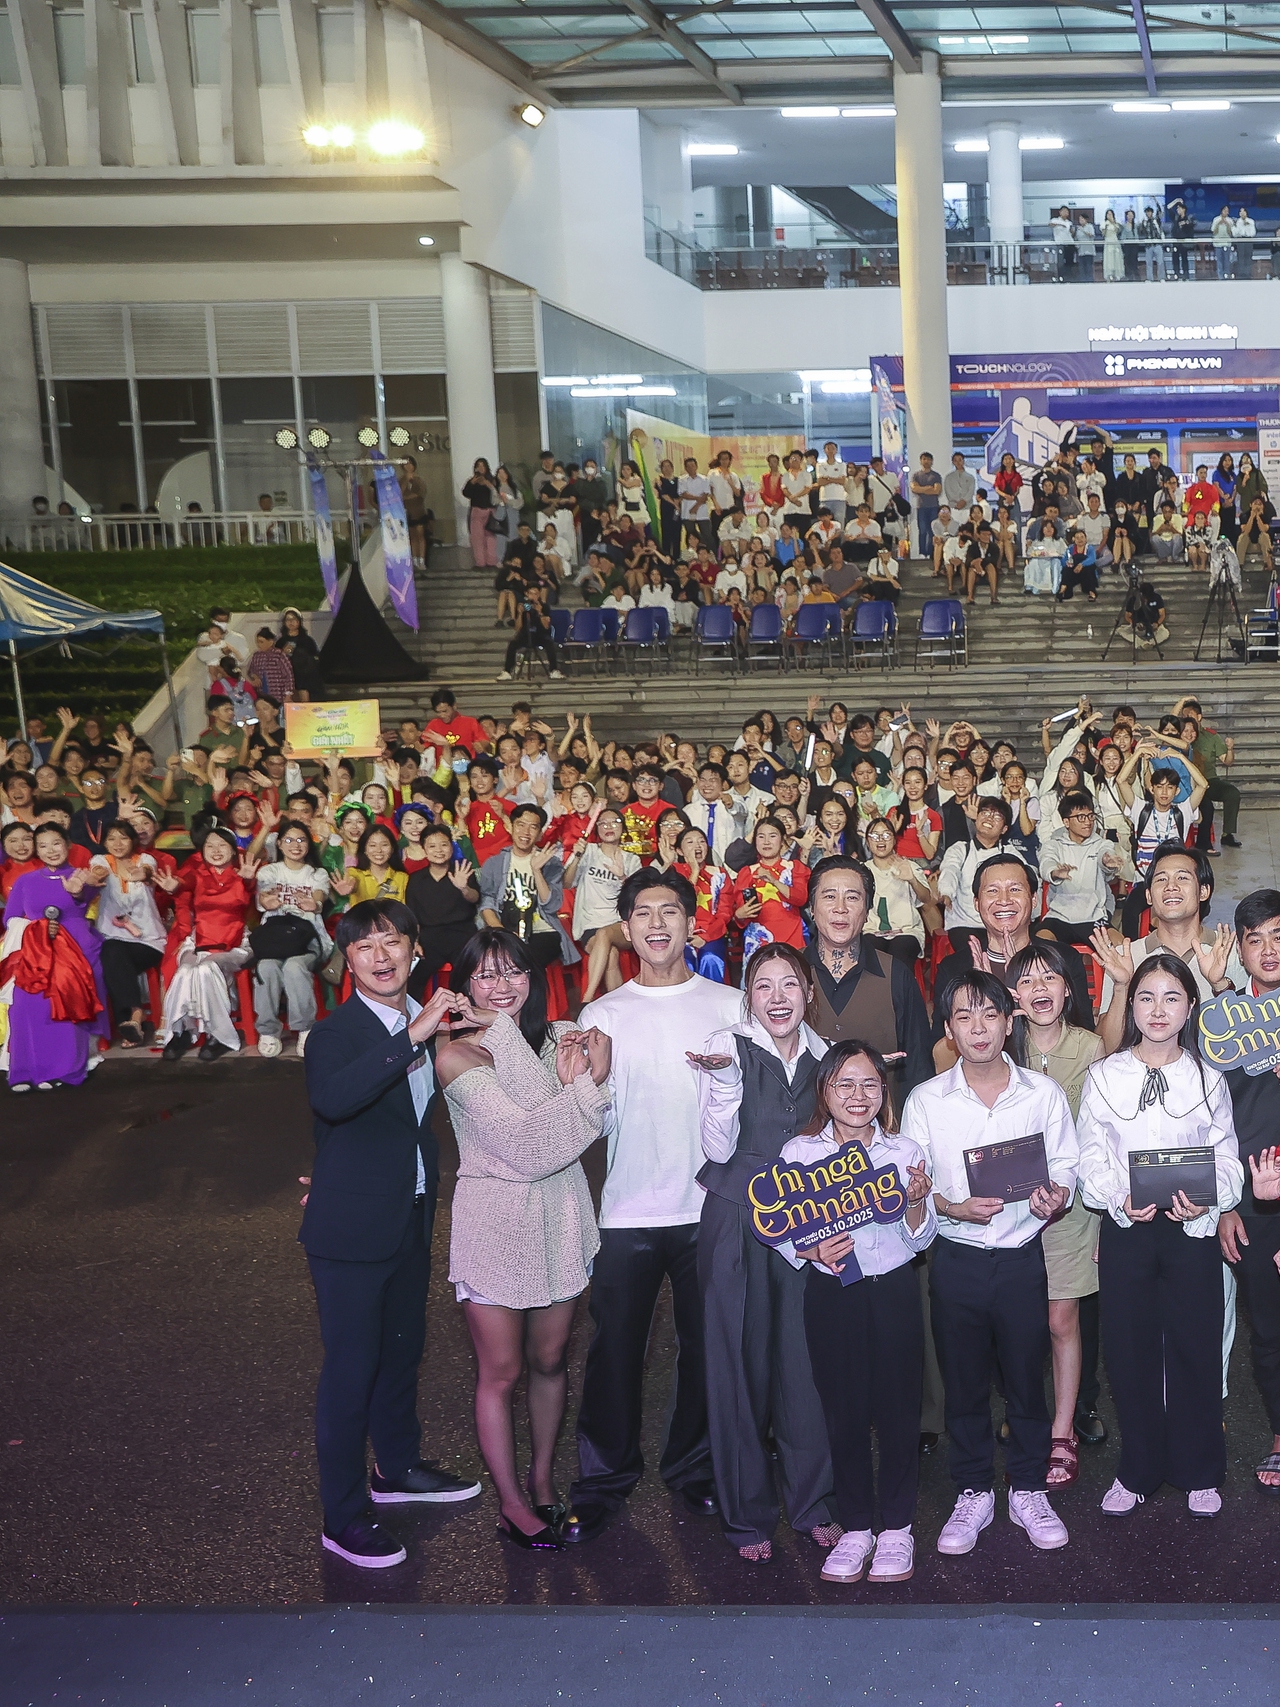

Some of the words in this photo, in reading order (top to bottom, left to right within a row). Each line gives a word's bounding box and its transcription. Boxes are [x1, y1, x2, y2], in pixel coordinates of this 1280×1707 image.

[1125, 324, 1149, 343] HỘI
[1149, 324, 1175, 340] TÂN
[1176, 325, 1207, 340] SINH
[1208, 323, 1238, 339] VIÊN
[955, 362, 1052, 374] TOUCHNOLOGY
[588, 866, 618, 881] SMIL
[1198, 996, 1256, 1042] Chị
[747, 1164, 806, 1213] Chị
[805, 1145, 869, 1192] ngã
[818, 1207, 874, 1239] 03.10.2025
